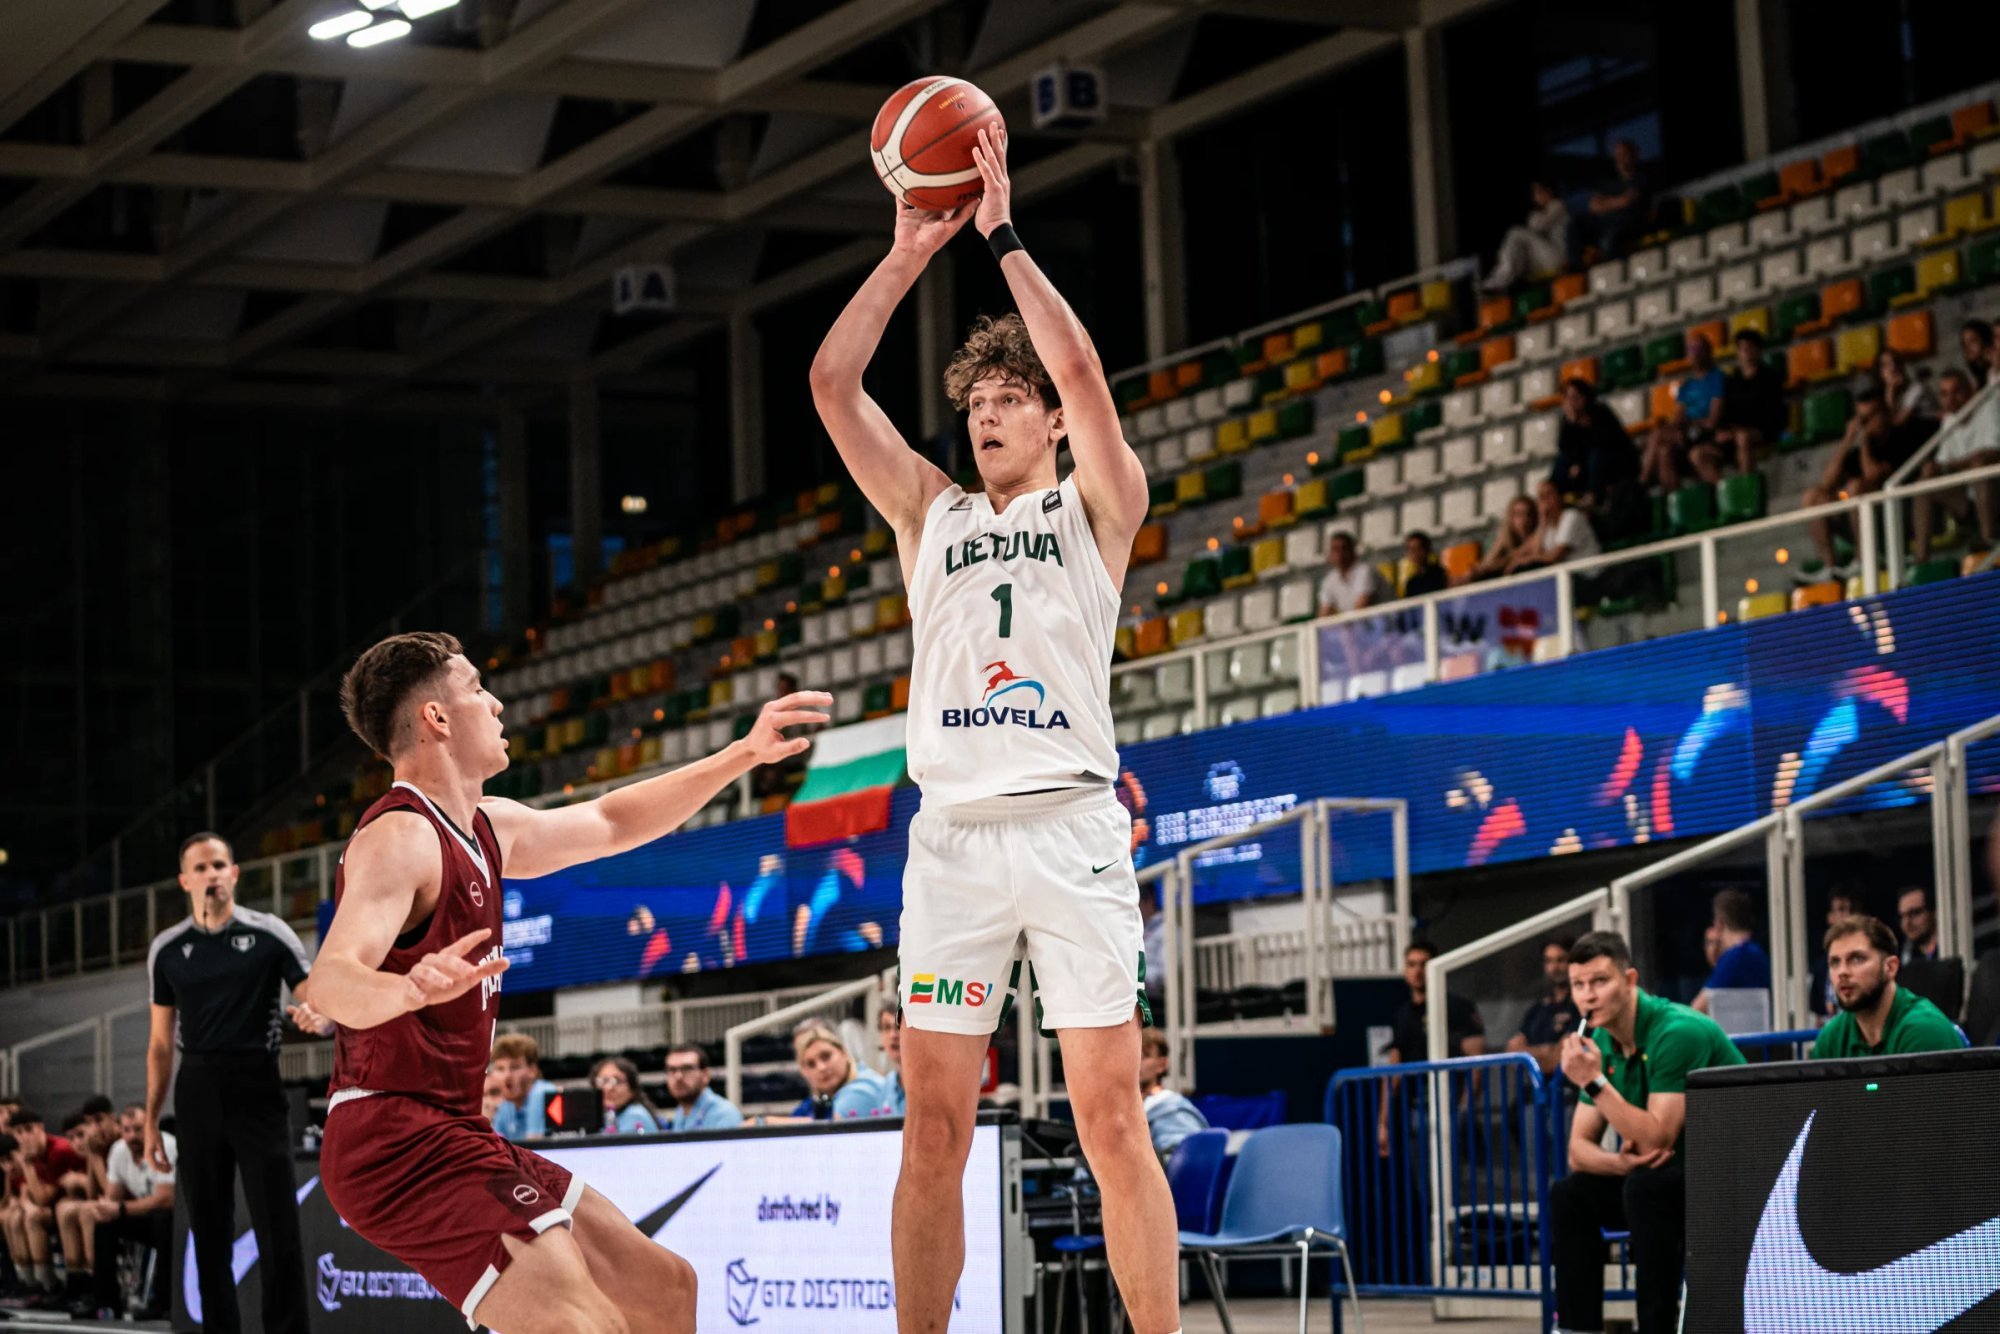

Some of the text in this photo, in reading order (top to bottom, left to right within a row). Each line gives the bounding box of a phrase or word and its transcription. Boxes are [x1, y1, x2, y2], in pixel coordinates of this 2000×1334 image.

[945, 530, 1064, 576] LIETUVA
[990, 583, 1012, 638] 1
[941, 706, 1071, 729] BIOVELA
[757, 1194, 840, 1225] distributed by
[762, 1279, 960, 1310] GTZ DISTRIB
